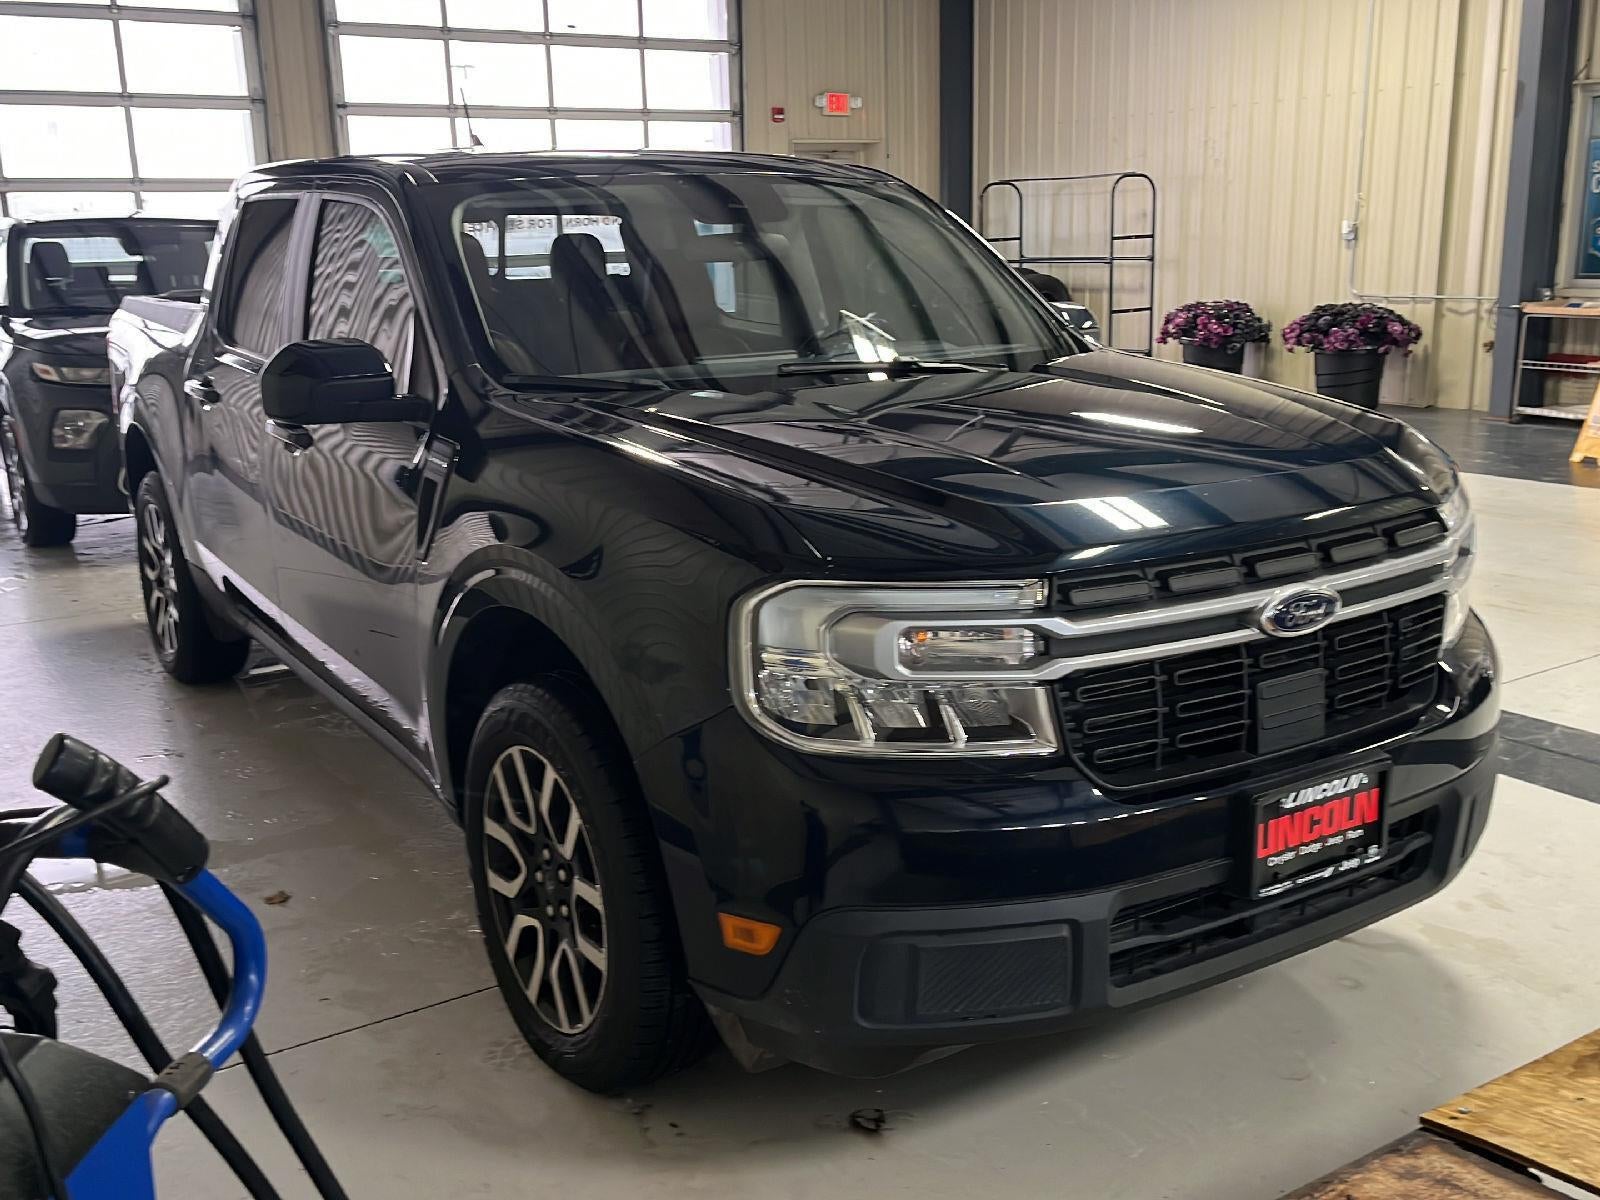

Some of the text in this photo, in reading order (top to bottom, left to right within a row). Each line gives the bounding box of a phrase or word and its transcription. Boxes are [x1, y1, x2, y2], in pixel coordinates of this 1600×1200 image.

[1285, 600, 1326, 627] Ford
[1283, 773, 1363, 808] LINCOLN
[1256, 787, 1380, 859] LINCOLN
